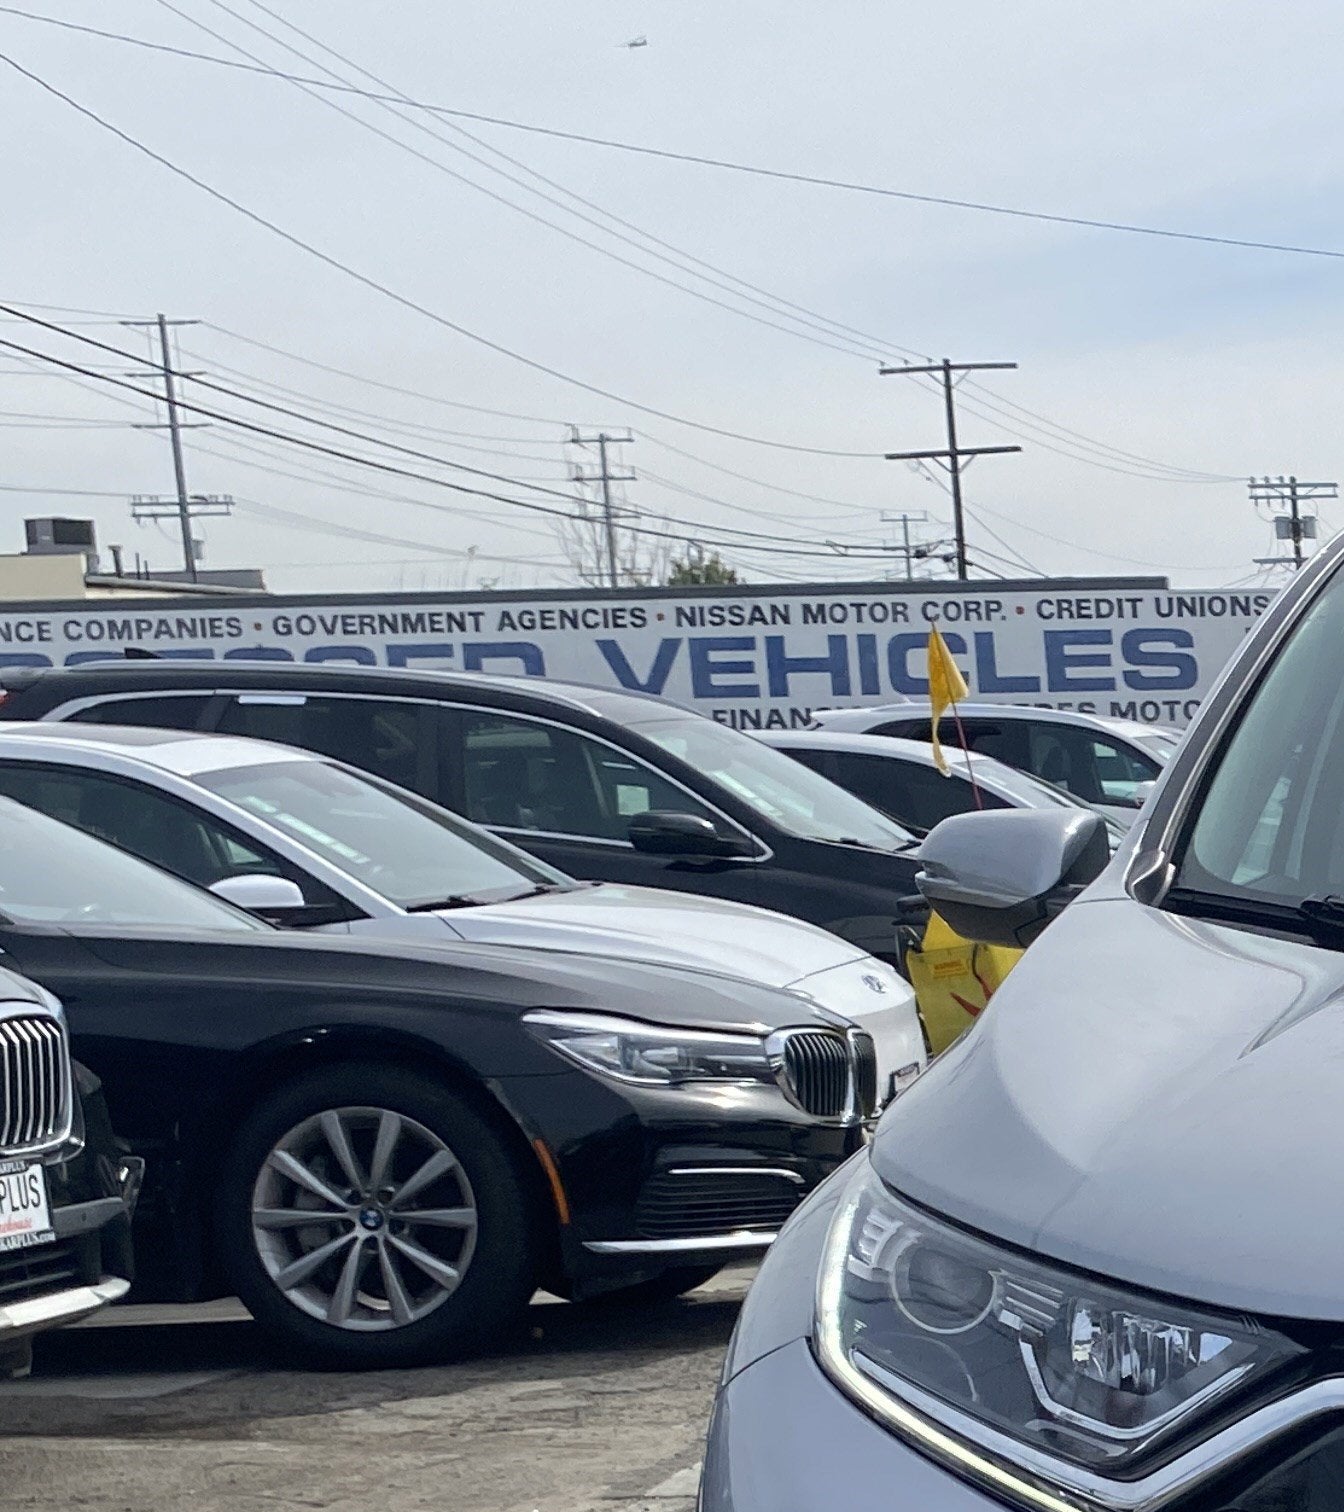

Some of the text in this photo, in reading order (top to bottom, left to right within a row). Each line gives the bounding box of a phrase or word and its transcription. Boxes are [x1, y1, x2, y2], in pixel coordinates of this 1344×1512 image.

[63, 617, 243, 643] COMPANIES
[272, 611, 485, 637] GOVERNMENT
[498, 607, 648, 632] AGENCIES
[675, 604, 791, 628] NISSAN
[802, 601, 910, 625] MOTOR
[921, 599, 1007, 623] CORP.
[1036, 597, 1143, 620] CREDIT
[1154, 594, 1270, 619] UNIONS
[594, 627, 1199, 699] VEHICLES
